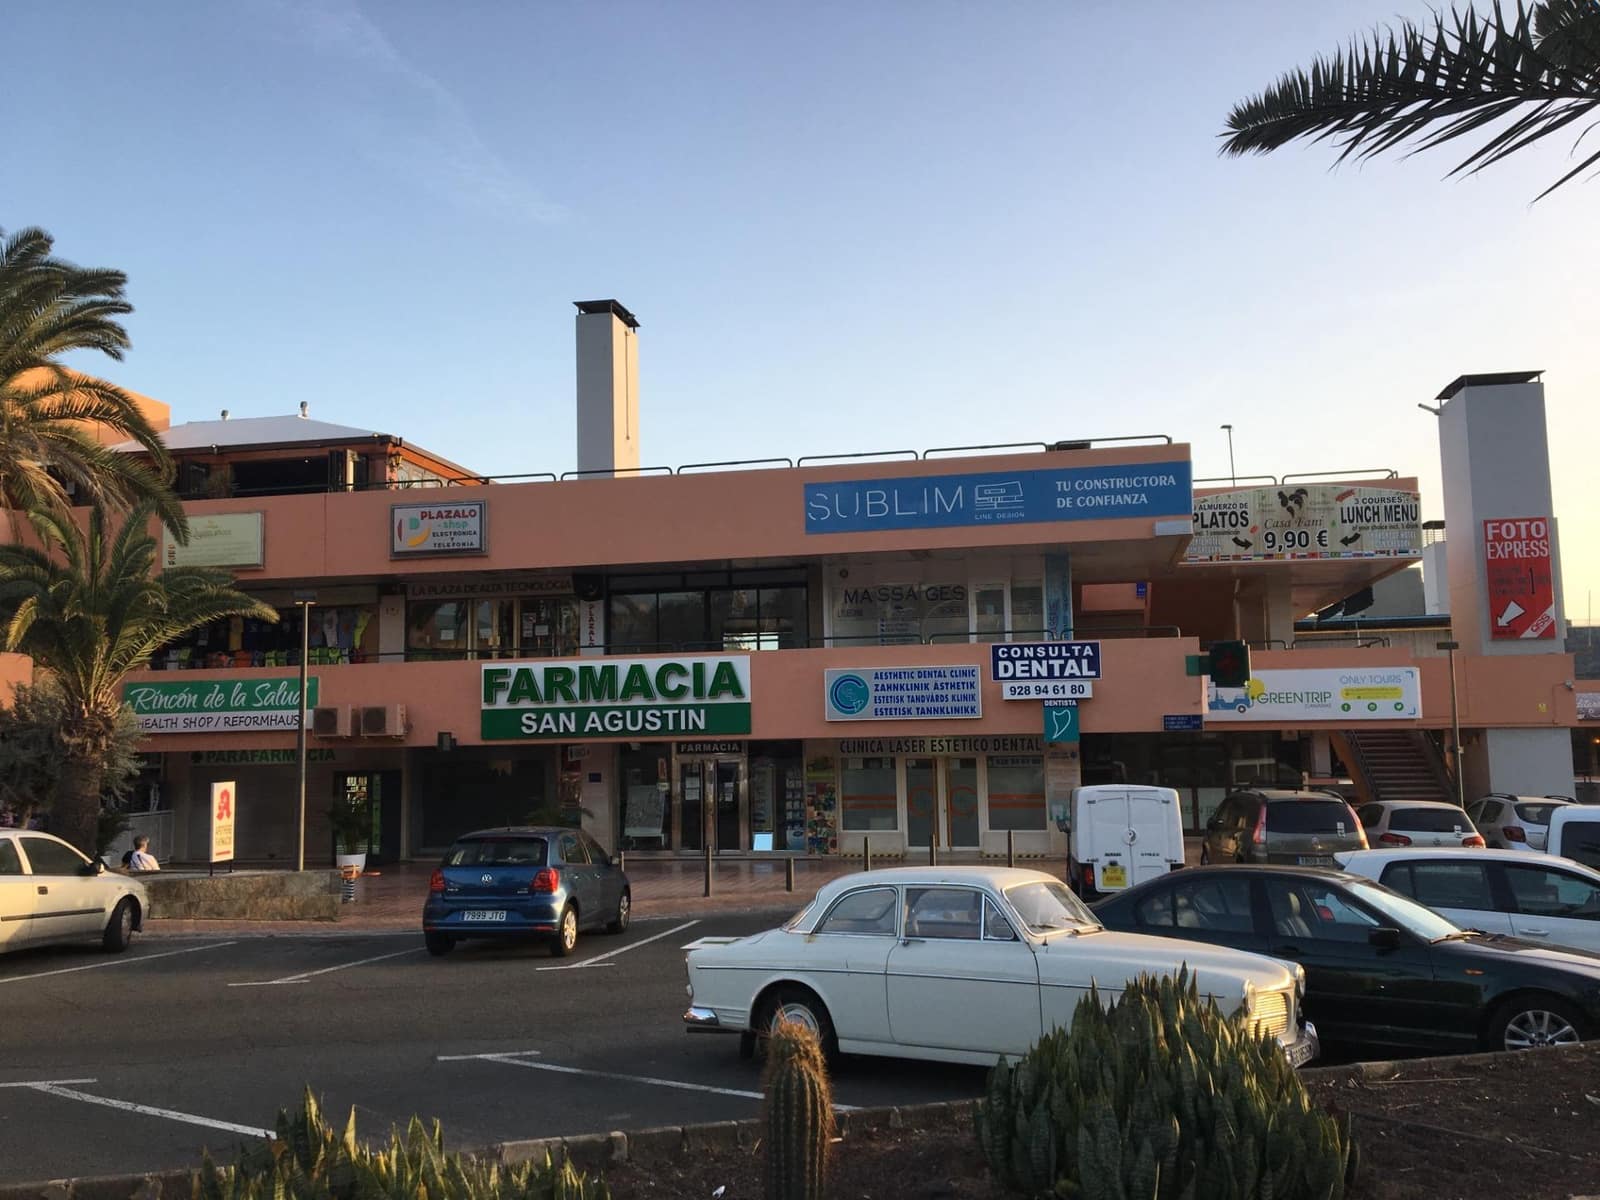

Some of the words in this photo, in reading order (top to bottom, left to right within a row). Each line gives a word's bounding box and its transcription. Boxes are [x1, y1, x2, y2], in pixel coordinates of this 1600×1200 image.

[1056, 480, 1072, 491] TU
[1074, 474, 1177, 491] CONSTRUCTORA
[807, 485, 964, 521] SUBLIM
[1056, 497, 1073, 508] DE
[1076, 493, 1148, 507] CONFIANZA
[1199, 502, 1238, 511] ALMUERZO
[1239, 502, 1249, 510] DE
[1361, 496, 1403, 505] COURSES
[420, 509, 477, 520] PLAZALO
[1340, 505, 1380, 524] LUNCH
[1383, 503, 1418, 522] MENU
[1264, 518, 1291, 529] Casa
[1487, 521, 1546, 540] FOTO
[1264, 531, 1310, 552] 9,90
[1316, 530, 1328, 547] €
[1487, 540, 1549, 560] EXPRESS
[998, 645, 1094, 658] CONSULTA
[874, 671, 915, 680] AESTHETIC
[917, 670, 947, 679] DENTAL
[950, 669, 976, 678] CLINIC
[998, 659, 1097, 678] DENTAL
[483, 661, 745, 704] FARMACIA
[1339, 675, 1367, 685] ONLY
[1368, 674, 1402, 684] TOURS
[874, 682, 930, 692] ZAHNKLINIK
[1009, 685, 1031, 696] 928
[1034, 684, 1049, 695] 94
[1052, 684, 1066, 695] 61
[1070, 684, 1085, 695] 80
[130, 687, 198, 711] Rincón
[203, 684, 225, 708] de
[230, 682, 247, 708] la
[874, 695, 905, 704] ESTETISK
[951, 693, 976, 702] KLINIK
[1044, 699, 1078, 707] DENTISTA
[874, 707, 913, 716] ESTETISK
[916, 705, 977, 715] TANNKLINIKK
[183, 715, 213, 728] SHOP
[223, 714, 301, 728] REFORMHAUS
[521, 712, 576, 734] SAN
[584, 709, 706, 733] AGUSTIN
[680, 743, 740, 753] FARMACIA
[840, 739, 884, 754] CLINICA
[889, 739, 926, 753] LASER
[931, 738, 988, 753] ESTETICO
[993, 737, 1042, 751] DENTAL
[207, 749, 336, 764] PARAFARMCIA
[466, 911, 487, 921] 7999
[488, 911, 505, 920] JTG
